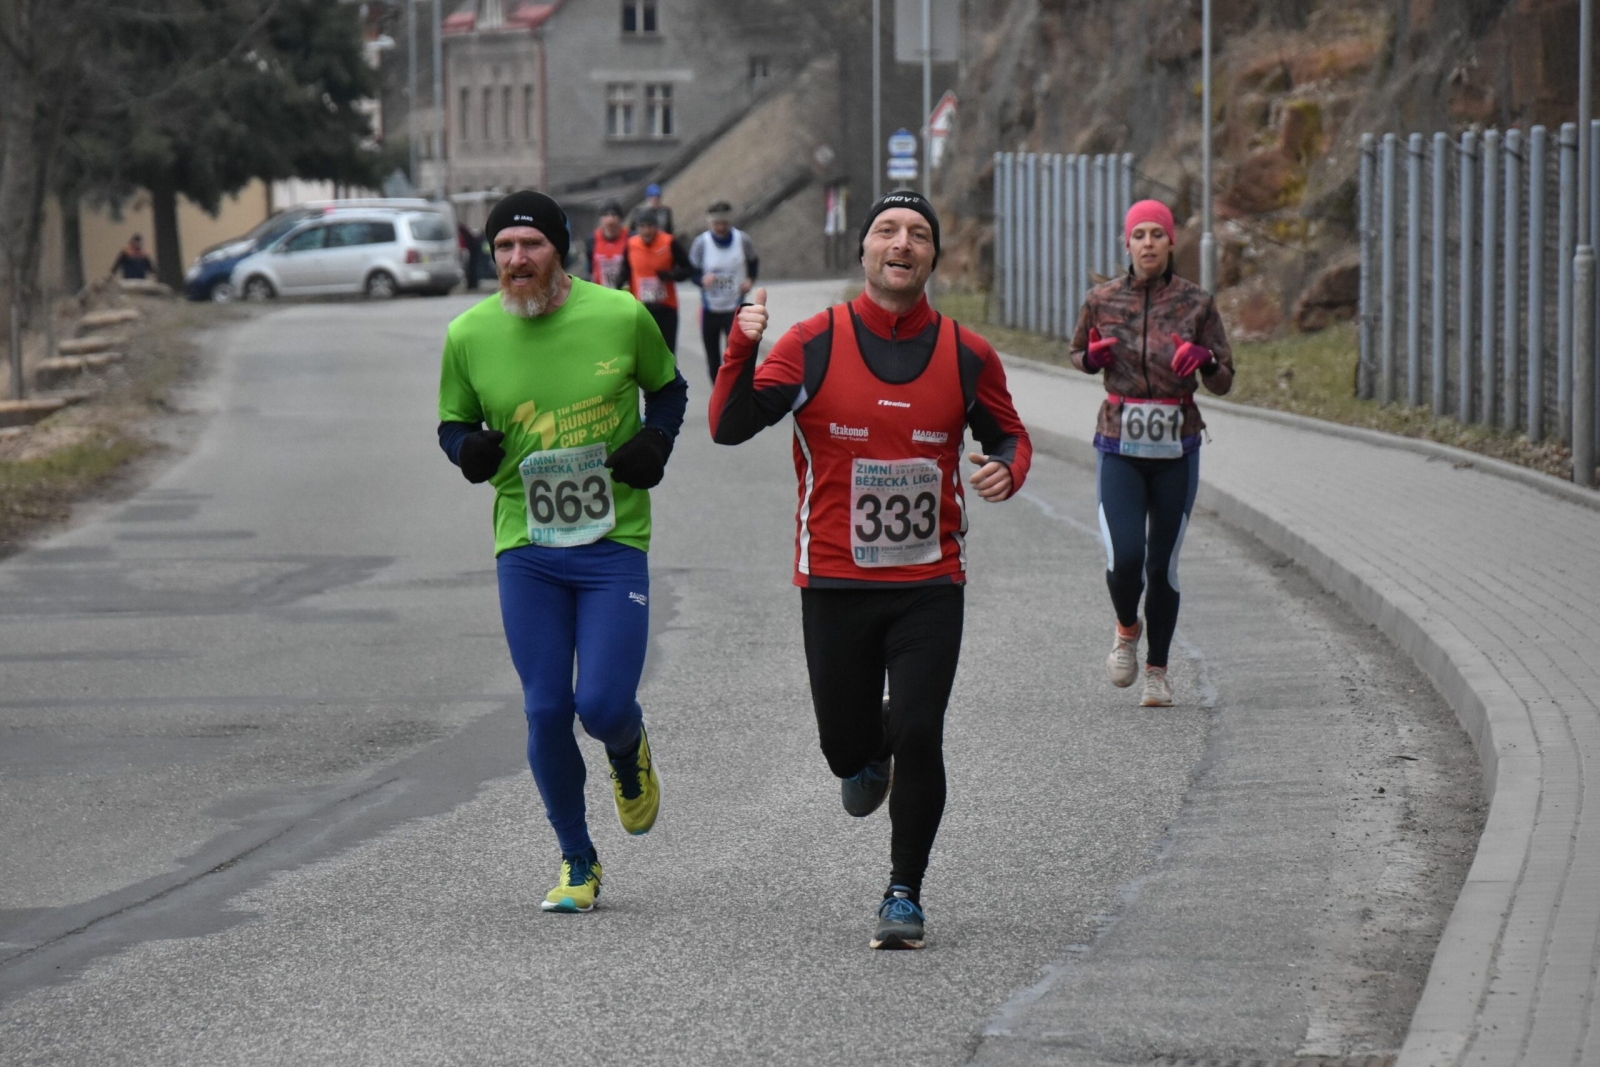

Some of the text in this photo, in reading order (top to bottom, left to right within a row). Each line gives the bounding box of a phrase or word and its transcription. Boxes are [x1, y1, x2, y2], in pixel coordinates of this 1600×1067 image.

[572, 395, 602, 411] MIZUNO
[560, 410, 620, 449] CUP 2015
[1126, 406, 1179, 442] 661
[912, 429, 949, 440] MARATON
[523, 453, 556, 468] ZIMNÍ
[578, 458, 605, 472] LIGA
[856, 463, 893, 475] ZIMNÍ
[855, 473, 939, 487] BĚŽECKÁ LIGA
[529, 475, 611, 525] 663
[855, 491, 937, 543] 333
